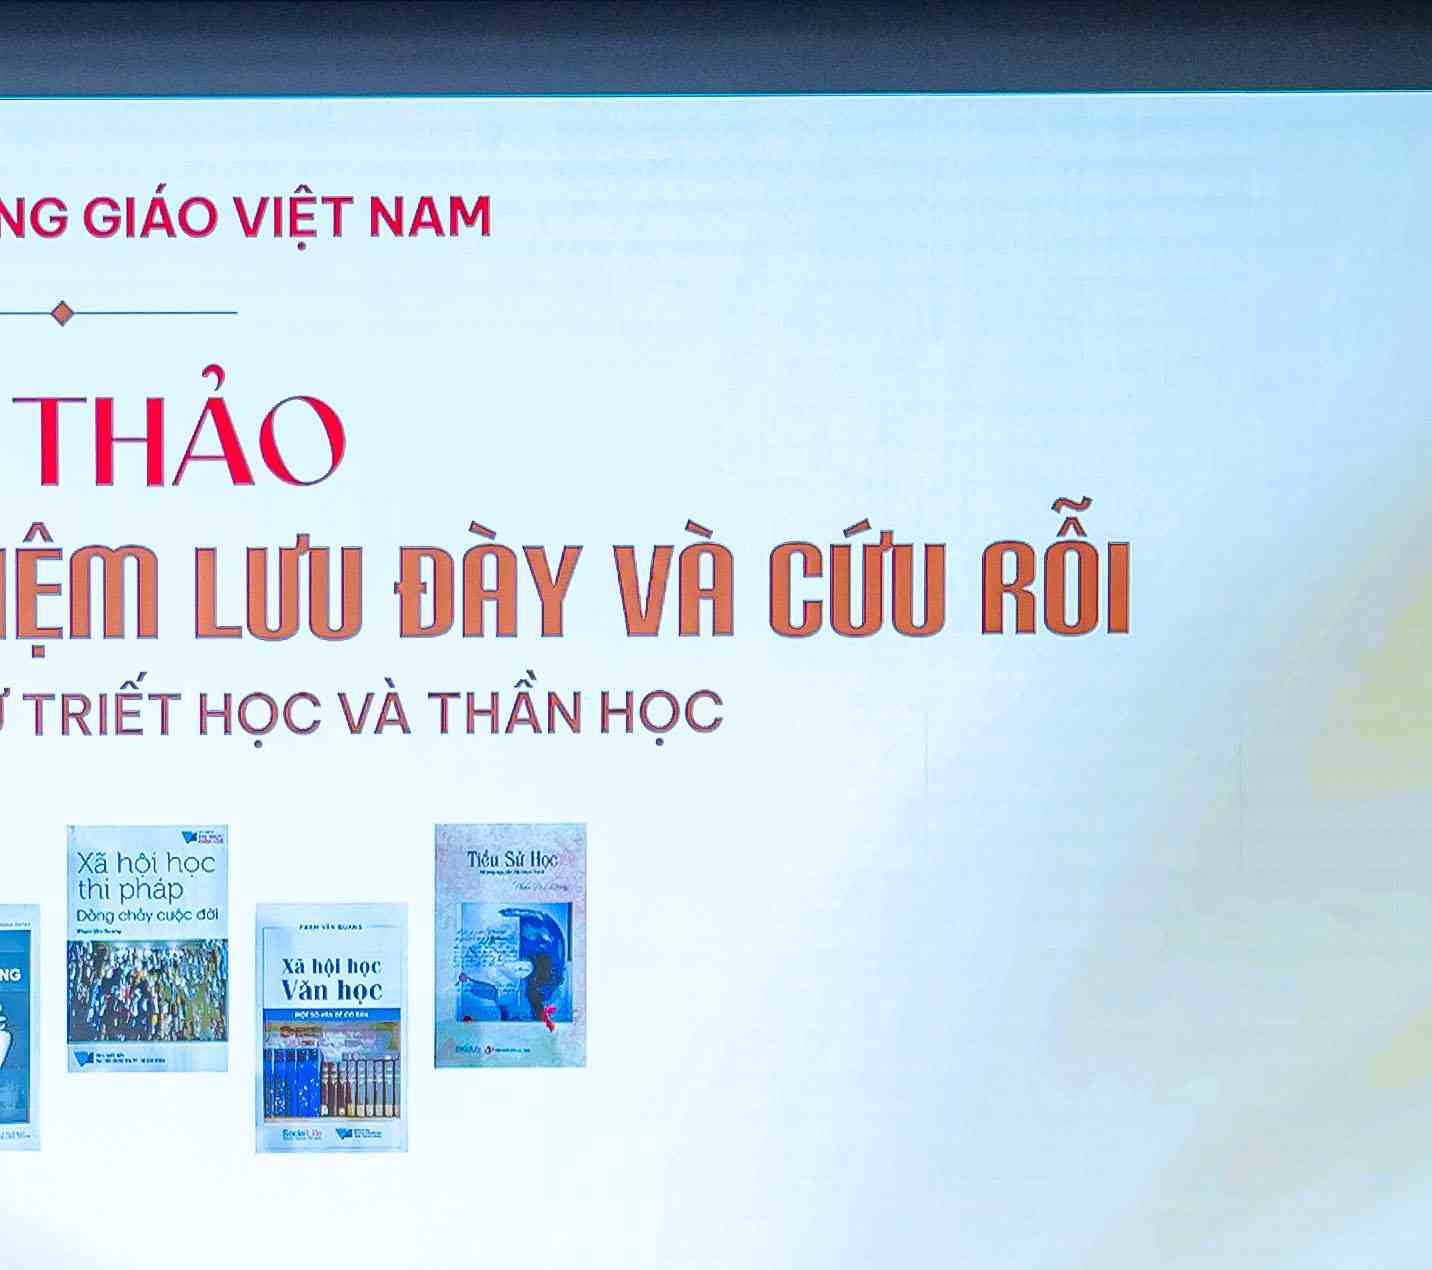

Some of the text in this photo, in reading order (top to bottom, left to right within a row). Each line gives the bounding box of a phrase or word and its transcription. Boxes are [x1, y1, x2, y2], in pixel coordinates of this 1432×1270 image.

[83, 183, 218, 239] GIÁO
[233, 184, 354, 251] VIỆT
[370, 195, 490, 237] NAM
[12, 364, 346, 487] THẢO
[195, 532, 363, 641] LƯU
[394, 521, 583, 638] ĐÀY
[612, 519, 734, 637] VÀ
[769, 518, 946, 638] CỨU
[981, 496, 1130, 637] RỖI
[22, 671, 181, 736] TRIẾT
[200, 691, 321, 748] HỌC
[337, 677, 411, 734] VÀ
[428, 669, 581, 736] THẦN
[601, 689, 723, 746] HỌC
[77, 851, 216, 878] Xã hội học
[78, 876, 184, 904] thi pháp
[157, 907, 192, 923] cuộc
[282, 957, 381, 978] Xã hội học
[282, 979, 383, 1005] Văn học
